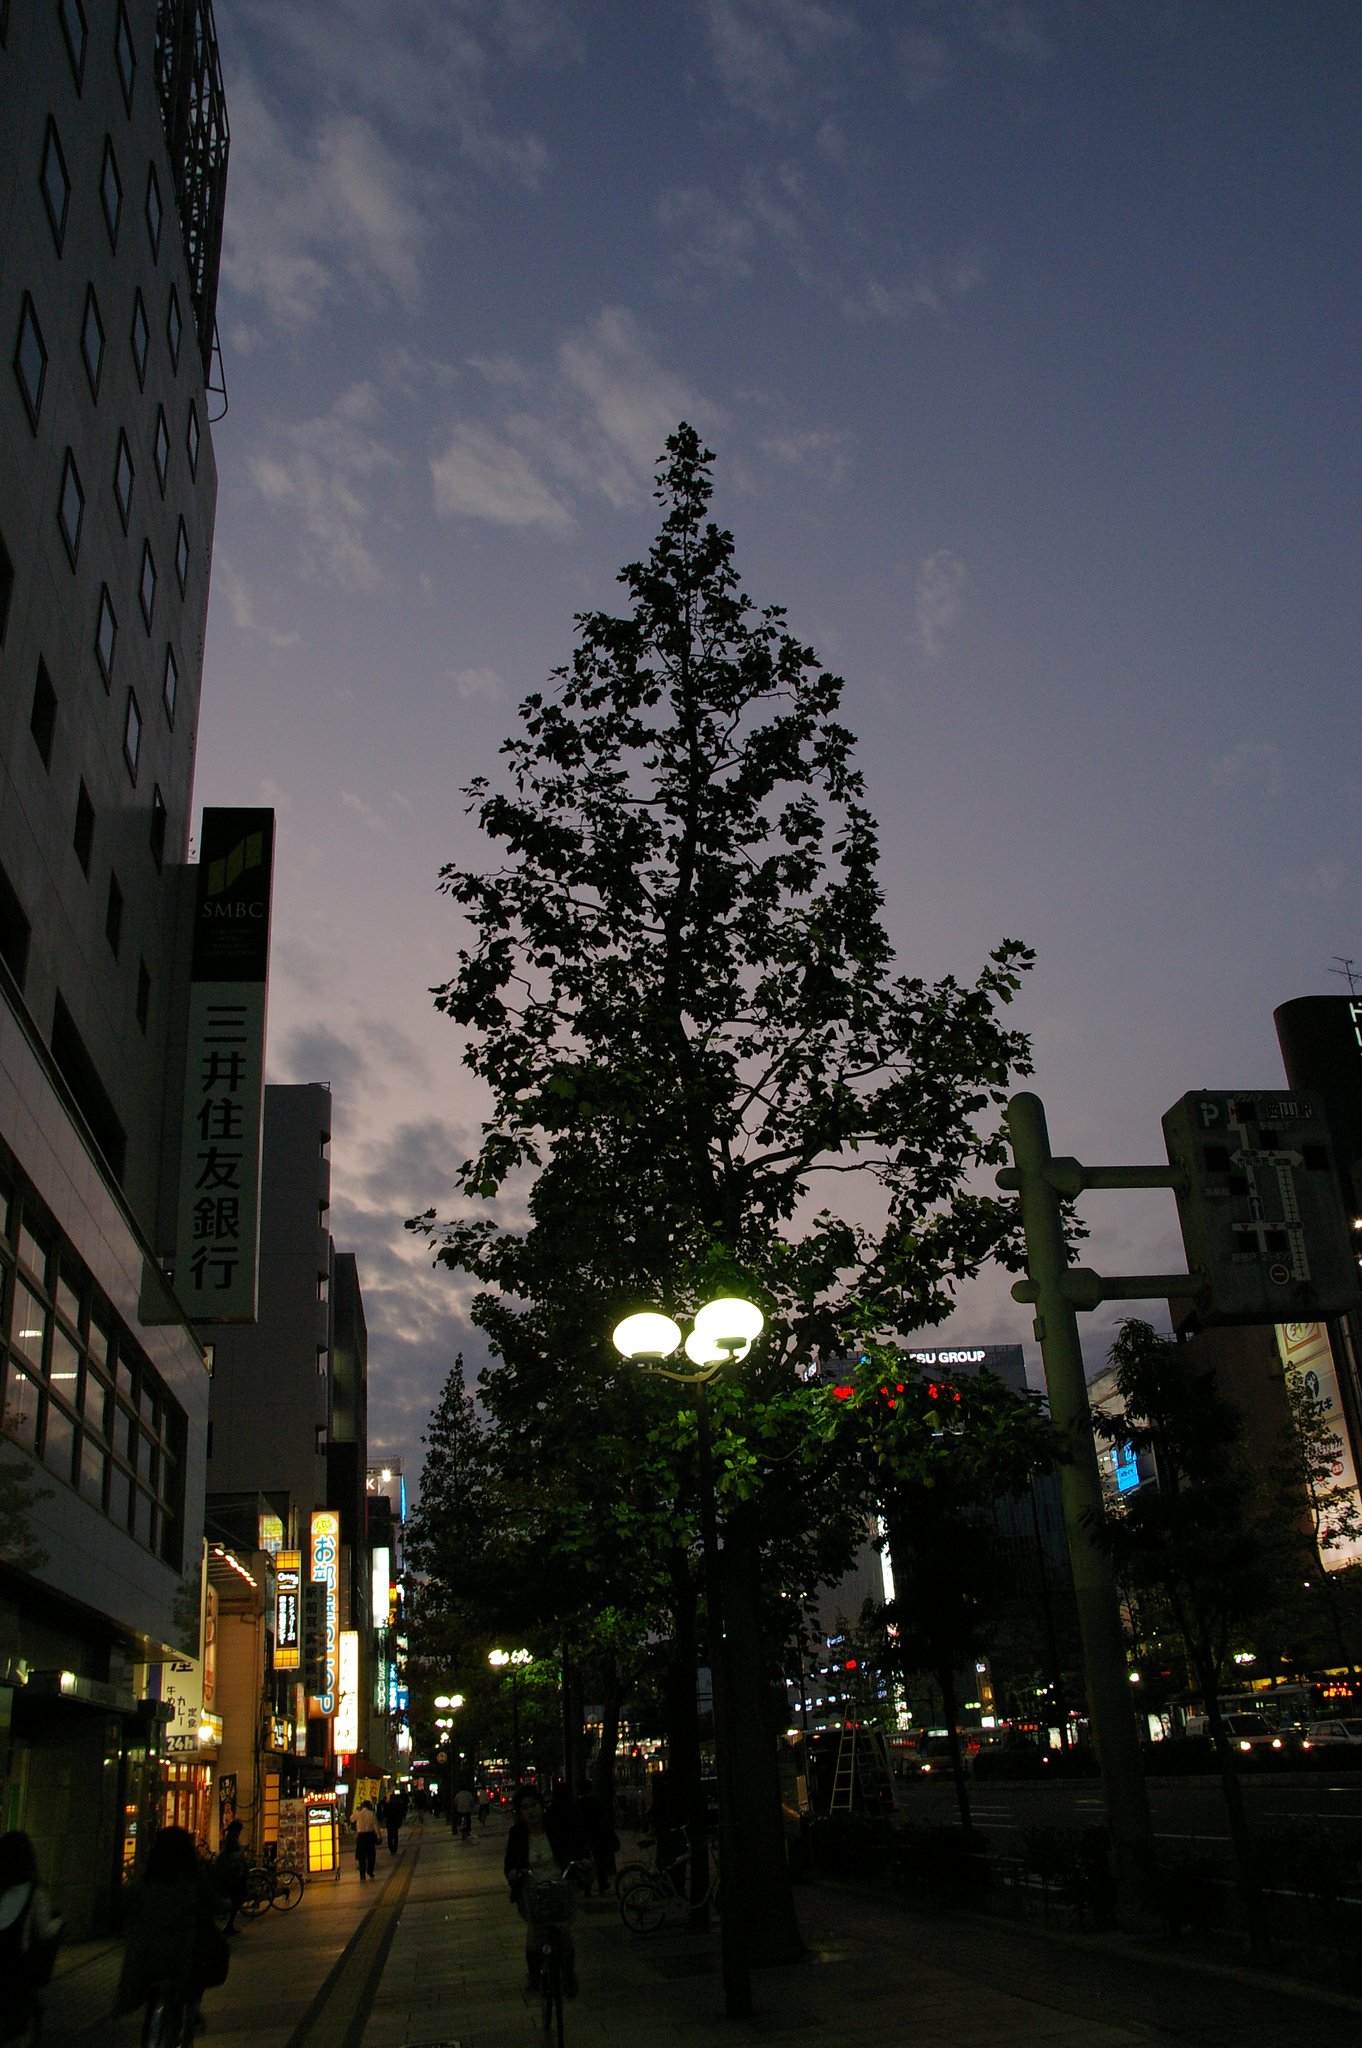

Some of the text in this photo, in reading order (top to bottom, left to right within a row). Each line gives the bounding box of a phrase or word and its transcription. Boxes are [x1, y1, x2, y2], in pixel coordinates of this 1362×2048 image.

[202, 901, 264, 918] SMBC
[190, 1004, 247, 1291] 三井住友銀行
[938, 1350, 986, 1364] GROUP
[166, 1686, 176, 1707] 牛め
[177, 1696, 186, 1726] カレー
[188, 1707, 197, 1728] 定食
[167, 1737, 194, 1752] 24h
